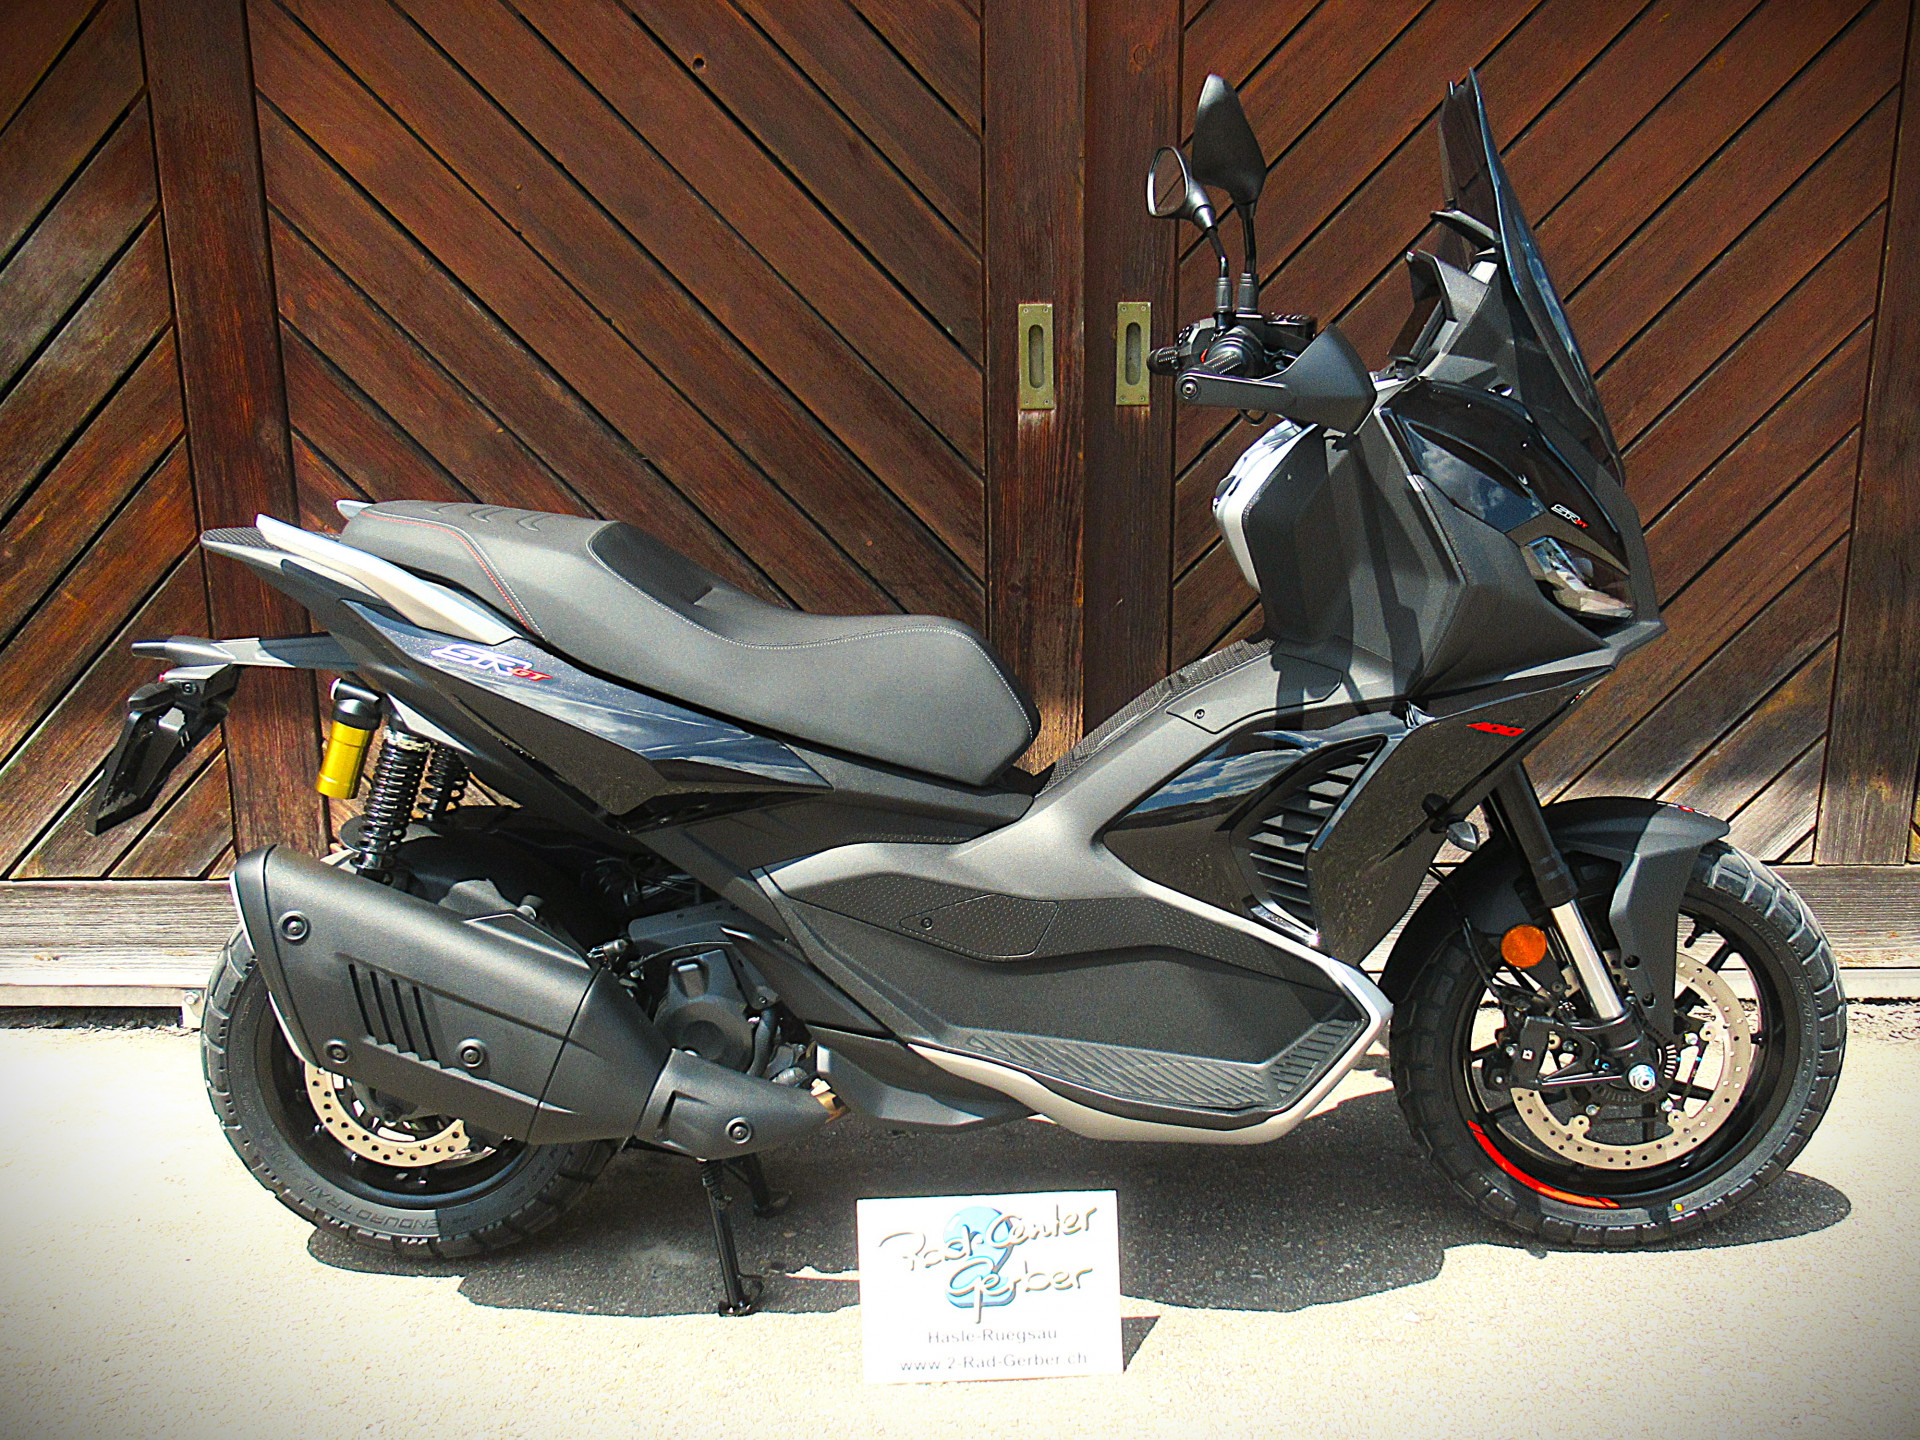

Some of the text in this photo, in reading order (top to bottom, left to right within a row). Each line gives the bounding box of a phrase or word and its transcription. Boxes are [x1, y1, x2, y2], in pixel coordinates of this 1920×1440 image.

[1550, 503, 1581, 525] SR
[430, 642, 553, 682] SR GT
[987, 1203, 1098, 1250] Center
[944, 1258, 1094, 1324] Gerber
[928, 1328, 1058, 1344] Hasle-Ruegsau
